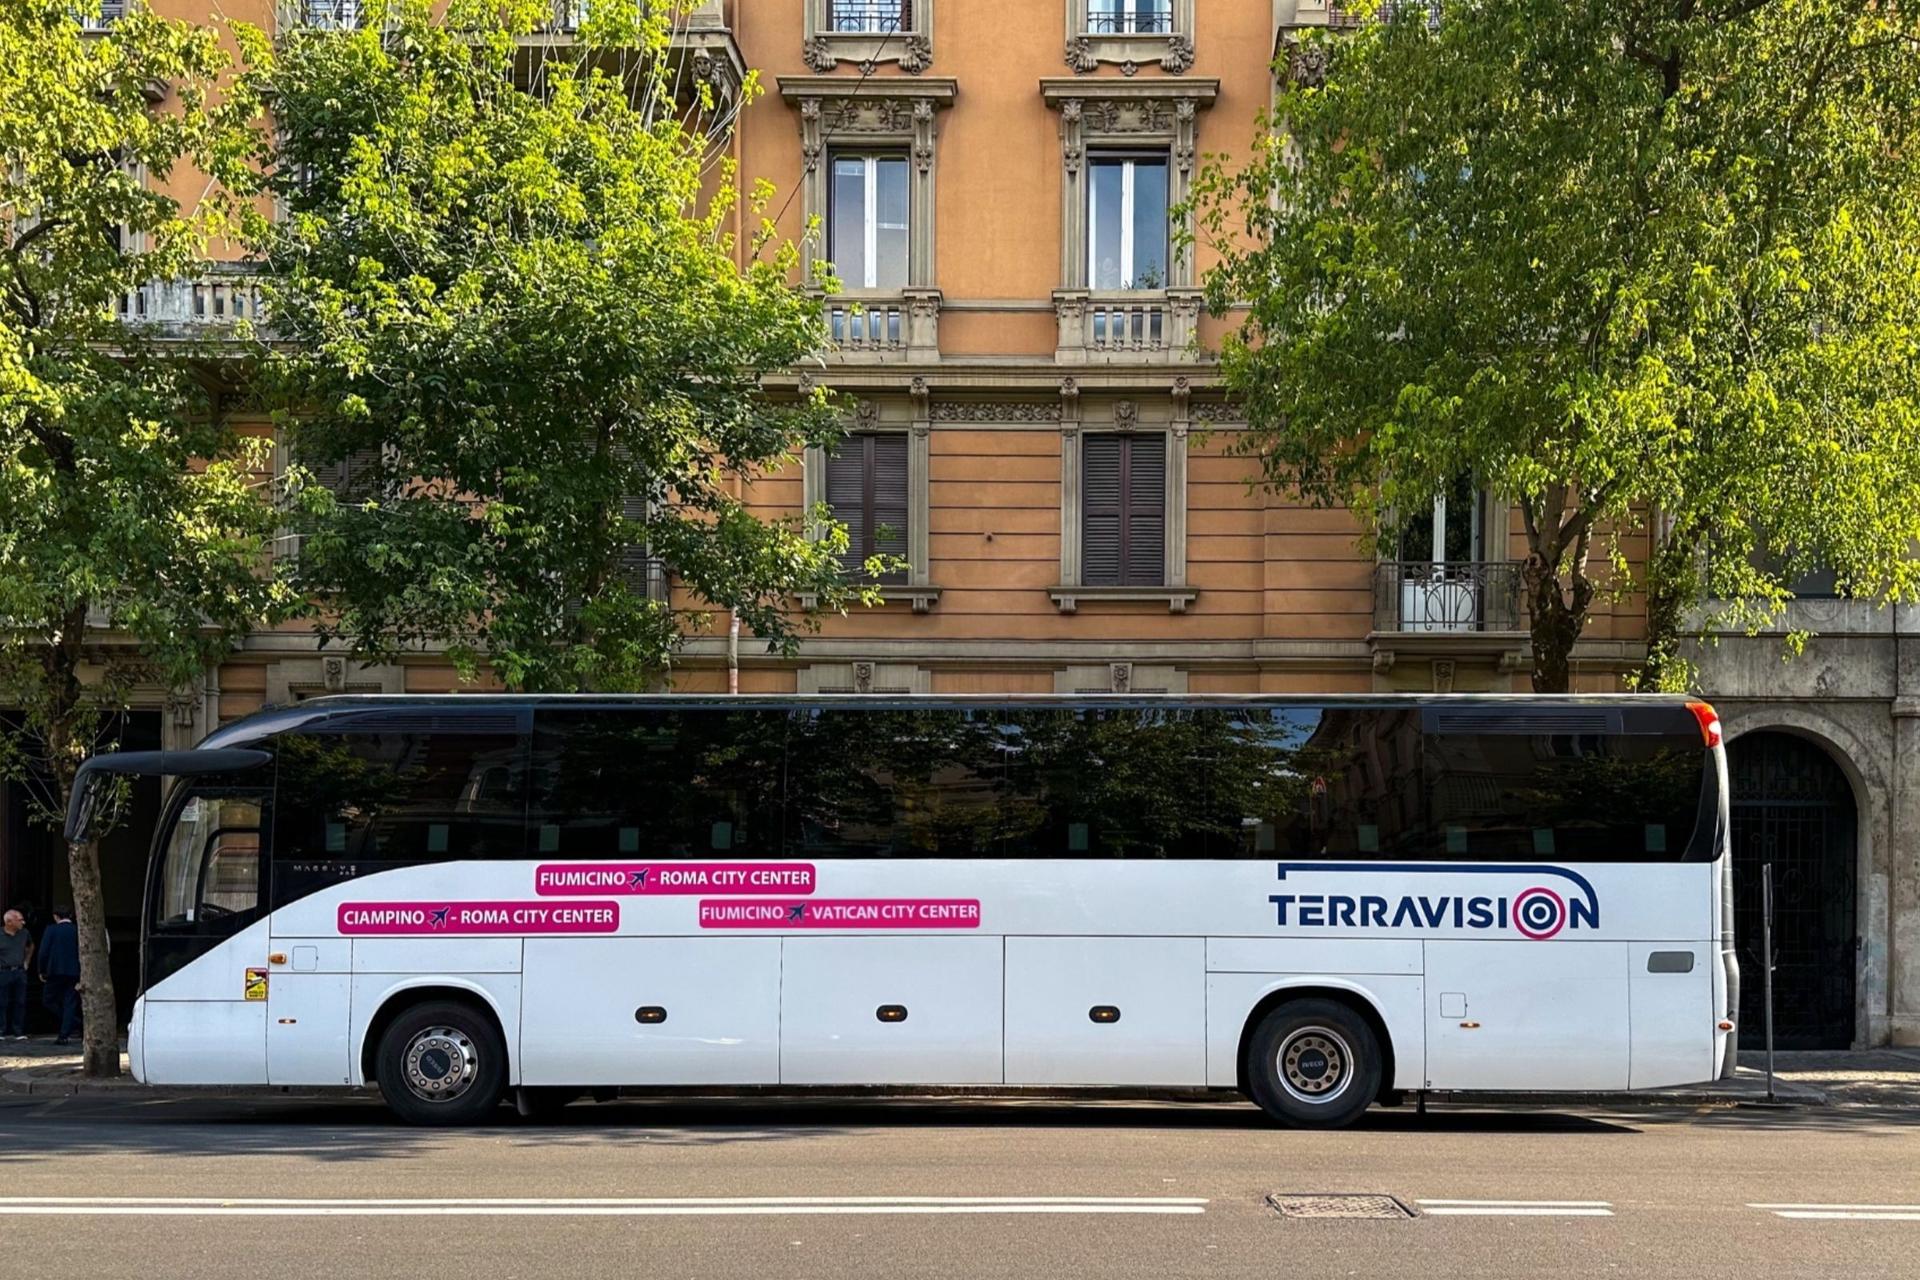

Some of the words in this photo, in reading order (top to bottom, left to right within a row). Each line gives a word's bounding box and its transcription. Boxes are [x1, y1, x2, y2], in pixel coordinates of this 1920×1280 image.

[540, 871, 626, 886] FIUMICINO
[660, 871, 708, 885] ROMA
[711, 870, 747, 885] CITY
[750, 870, 810, 885] CENTER
[343, 910, 425, 925] CIAMPINO
[460, 909, 509, 924] ROMA
[513, 909, 549, 924] CITY
[552, 909, 613, 923] CENTER
[701, 906, 784, 920] FIUMICINO
[812, 905, 878, 919] VATICAN
[881, 905, 916, 919] CITY
[919, 905, 978, 918] CENTER
[1269, 884, 1599, 940] TERRAVISION
